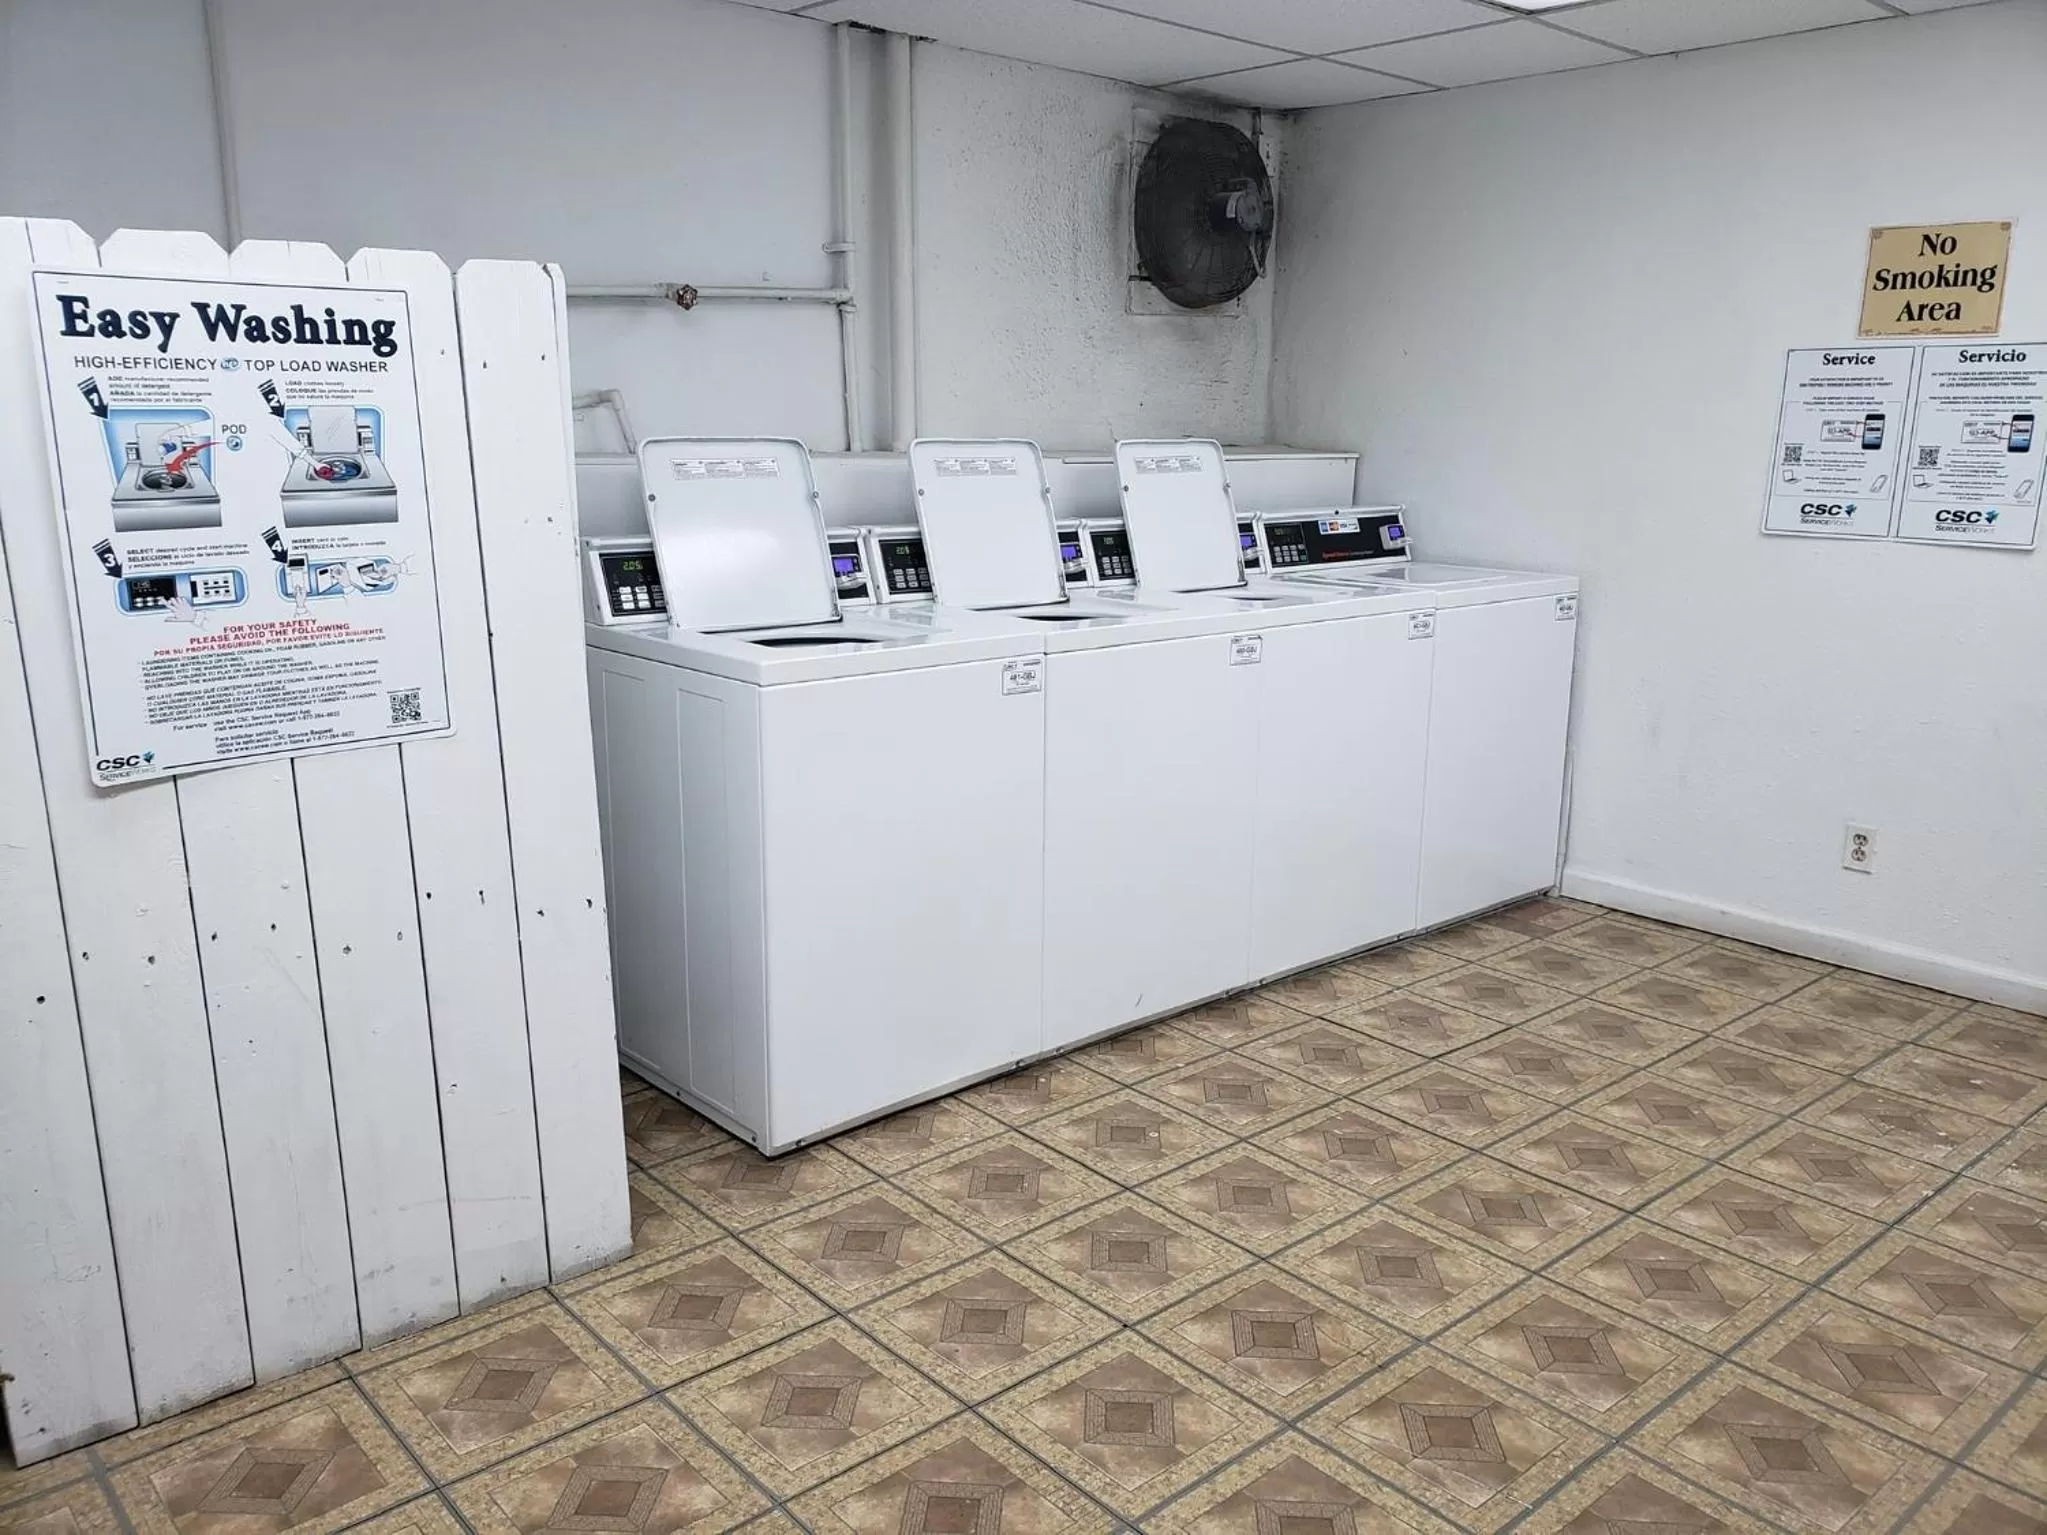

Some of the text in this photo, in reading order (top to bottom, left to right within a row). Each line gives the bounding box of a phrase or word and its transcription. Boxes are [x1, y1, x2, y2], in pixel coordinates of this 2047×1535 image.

[1918, 233, 1957, 257] No
[1872, 263, 1998, 293] Smoking
[1896, 300, 1961, 322] Area
[56, 294, 398, 358] Easy Washing
[1822, 352, 1876, 366] Service
[1958, 349, 2027, 363] Servicio
[75, 355, 218, 371] HIGH-EFFICIENCY
[245, 359, 275, 372] TOP
[280, 359, 322, 373] LOAD
[326, 359, 388, 373] WASHER
[89, 392, 99, 406] 1
[268, 394, 279, 406] 2
[221, 424, 247, 434] POD
[1800, 503, 1842, 516] CSC
[1935, 509, 1982, 523] CSC
[272, 541, 282, 552] 4
[104, 554, 115, 567] 3
[223, 619, 317, 633] FOR YOUR SAFETY
[190, 623, 350, 644] PLEASE AVOID THE FOLLOWING
[96, 754, 141, 771] CSC
